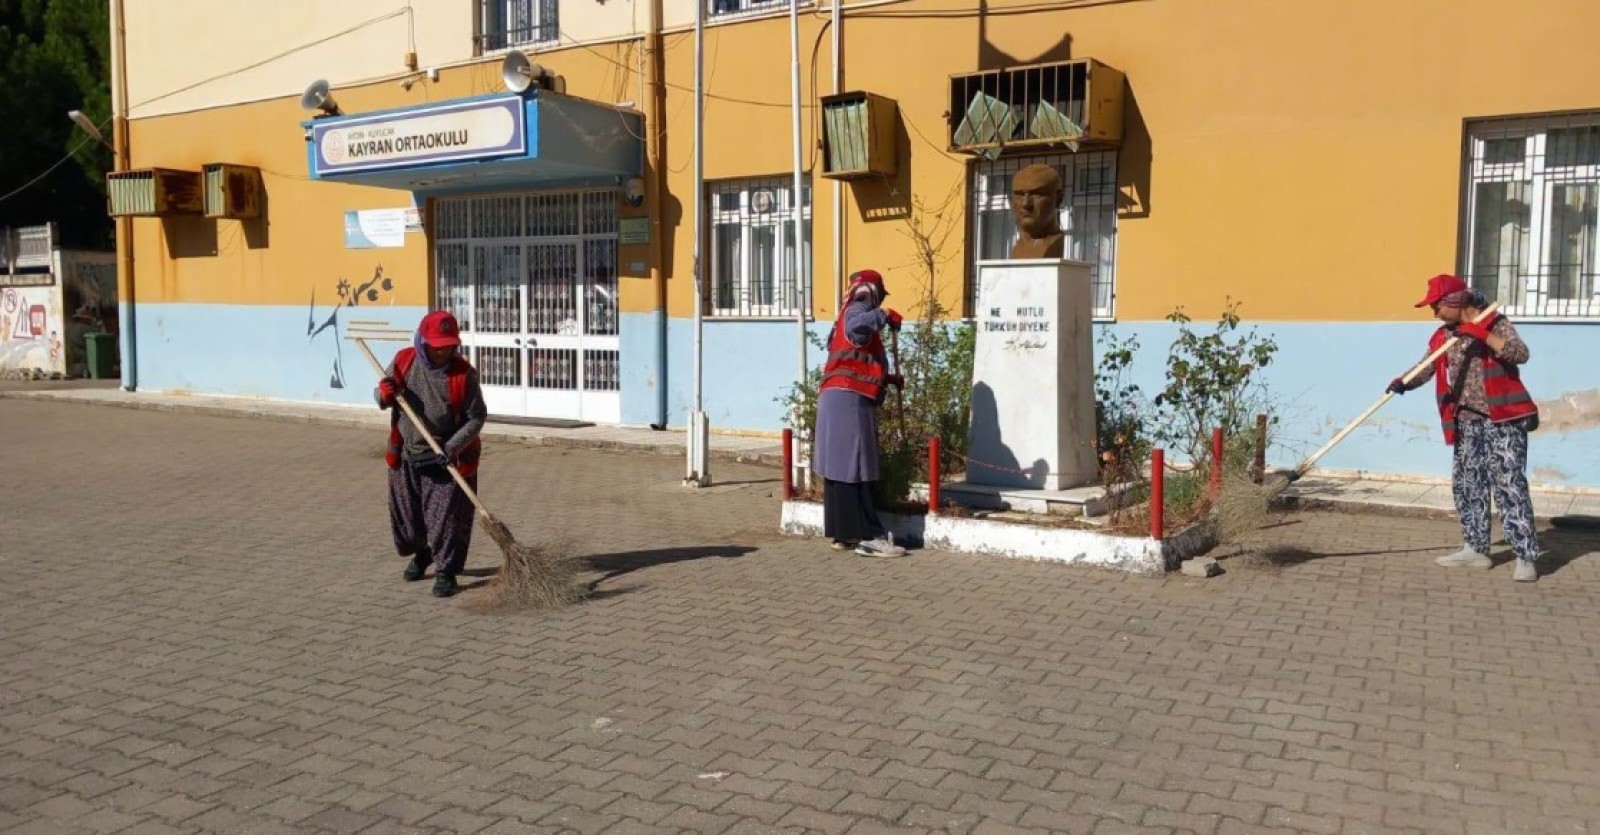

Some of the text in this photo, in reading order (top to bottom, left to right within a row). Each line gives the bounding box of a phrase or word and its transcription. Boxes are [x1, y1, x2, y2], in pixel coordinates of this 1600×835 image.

[348, 129, 469, 158] KAYRAN ORTAOKULU
[990, 307, 1044, 317] NE MUTLU
